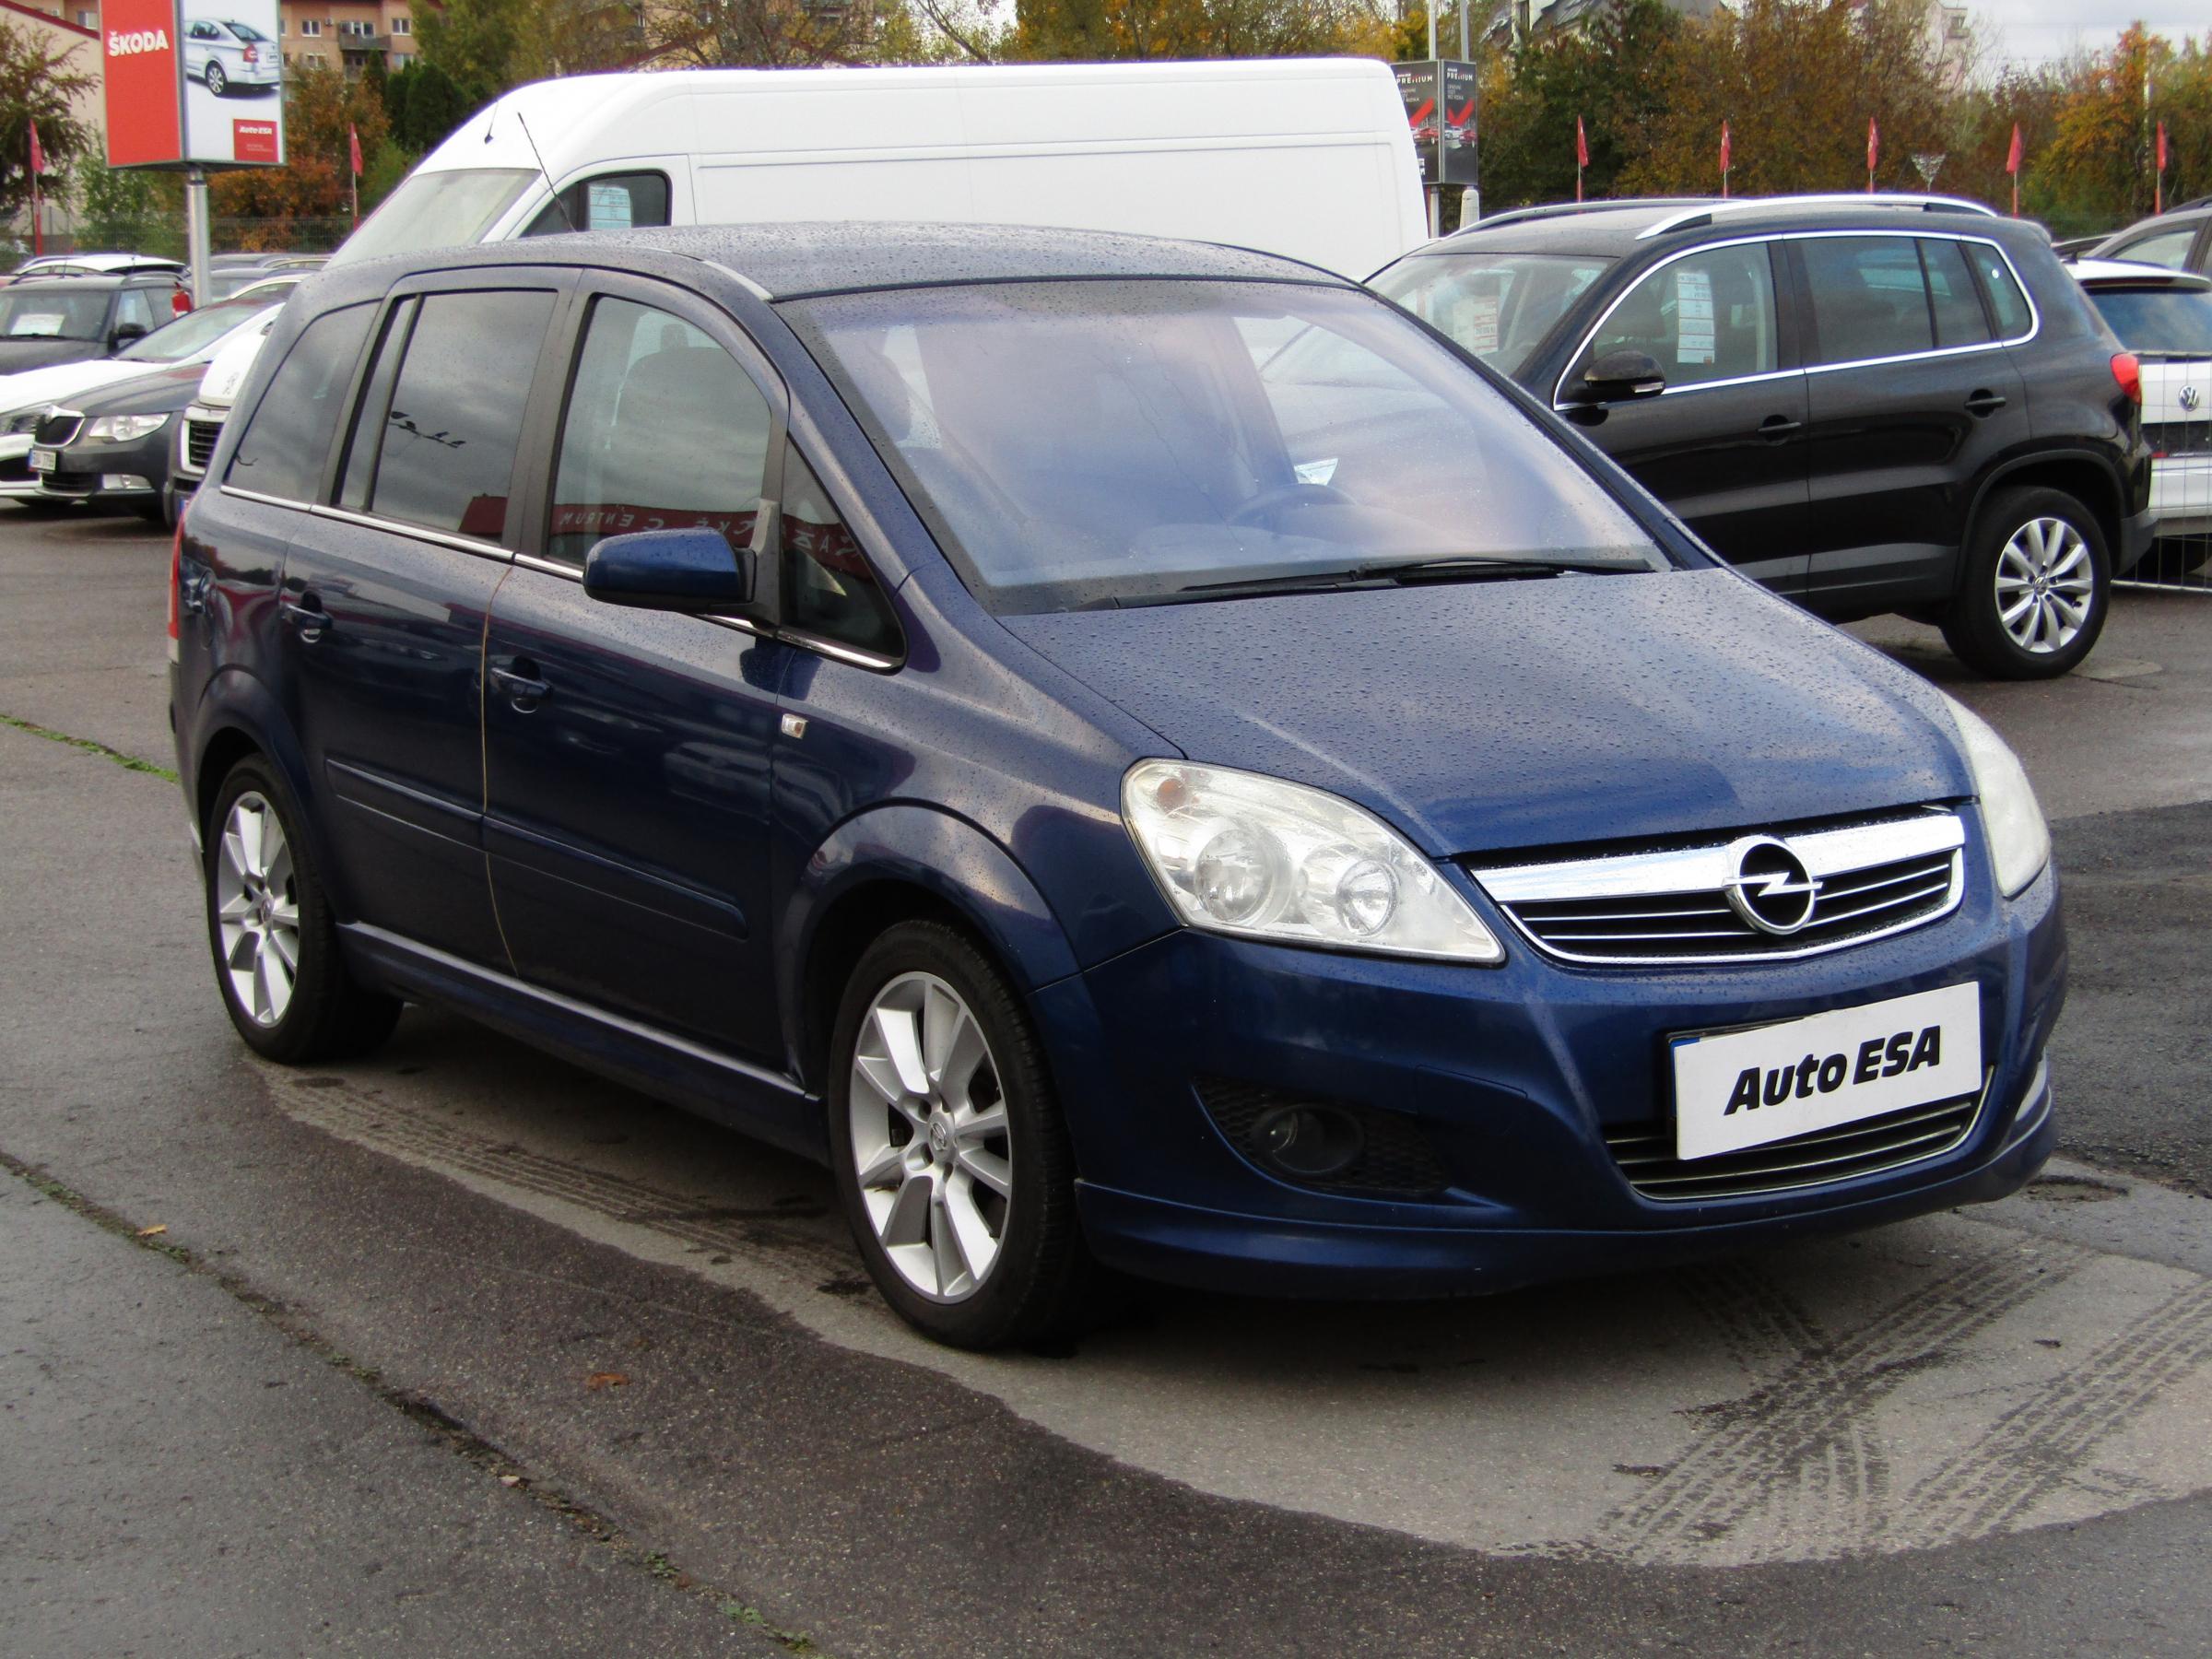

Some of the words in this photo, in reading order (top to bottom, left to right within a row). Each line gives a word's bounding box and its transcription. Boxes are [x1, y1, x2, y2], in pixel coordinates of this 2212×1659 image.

[109, 29, 170, 56] ŠKODA
[1724, 1053, 1847, 1116] Auto
[1853, 1025, 1941, 1086] ESA
